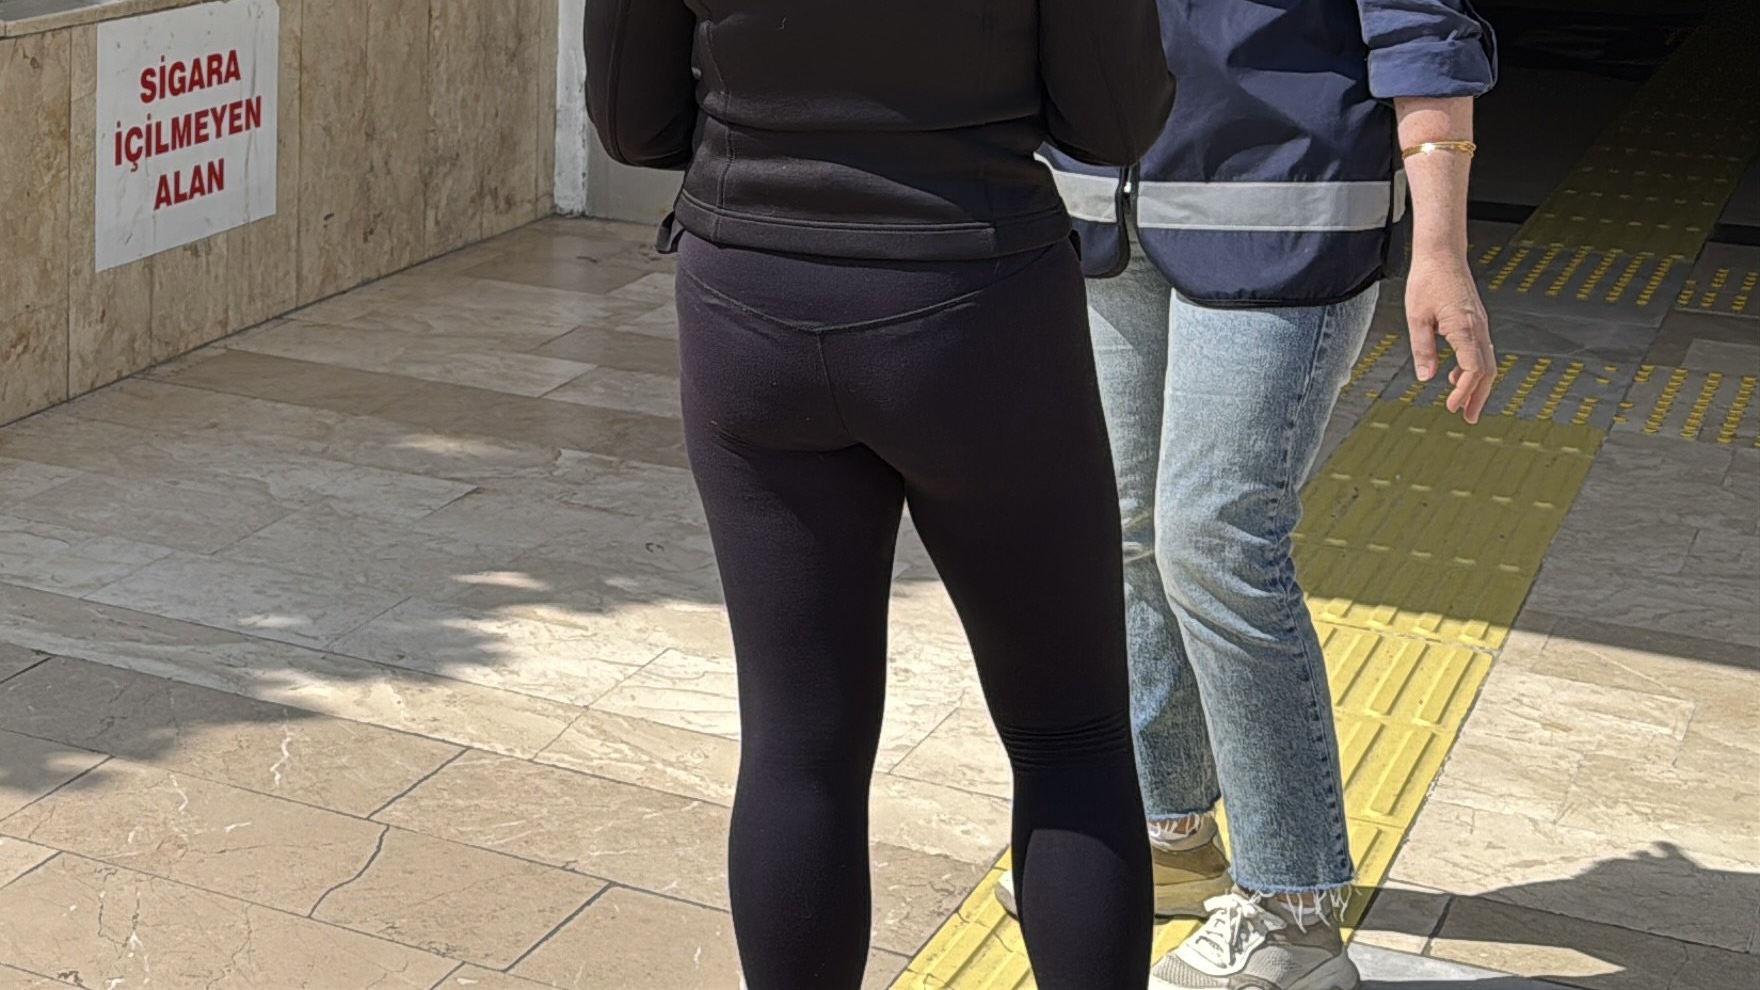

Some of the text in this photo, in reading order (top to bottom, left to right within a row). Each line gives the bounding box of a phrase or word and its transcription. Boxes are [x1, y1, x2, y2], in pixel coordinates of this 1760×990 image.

[140, 49, 241, 103] SİGARA
[114, 95, 262, 172] İÇİLMEYEN
[154, 157, 225, 211] ALAN
